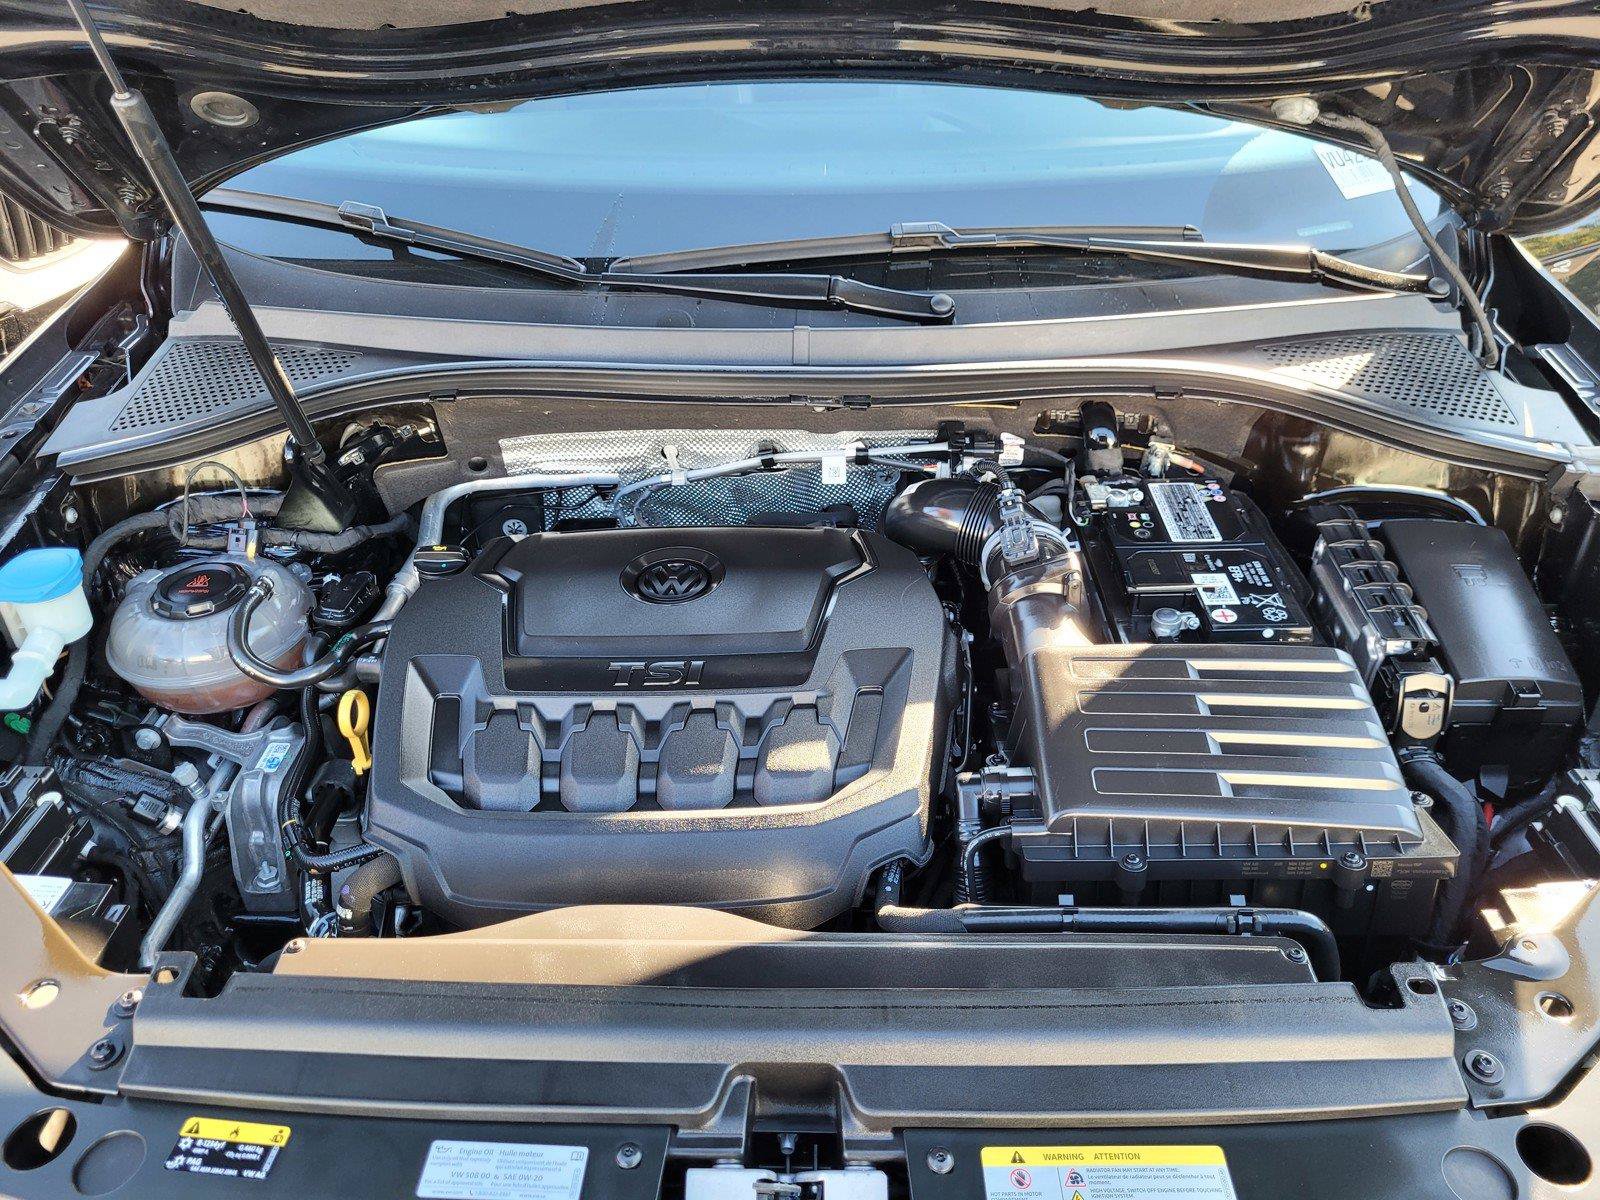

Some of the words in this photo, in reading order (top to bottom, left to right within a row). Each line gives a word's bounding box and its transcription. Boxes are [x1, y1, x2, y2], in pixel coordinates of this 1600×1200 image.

[637, 558, 709, 602] VW
[608, 660, 707, 687] TSI
[459, 1148, 483, 1156] Engine
[518, 1150, 544, 1158] moteur
[1042, 1152, 1085, 1161] WARNING
[1093, 1152, 1141, 1161] ATTENTION
[480, 1172, 491, 1180] 00
[503, 1173, 517, 1181] SAE
